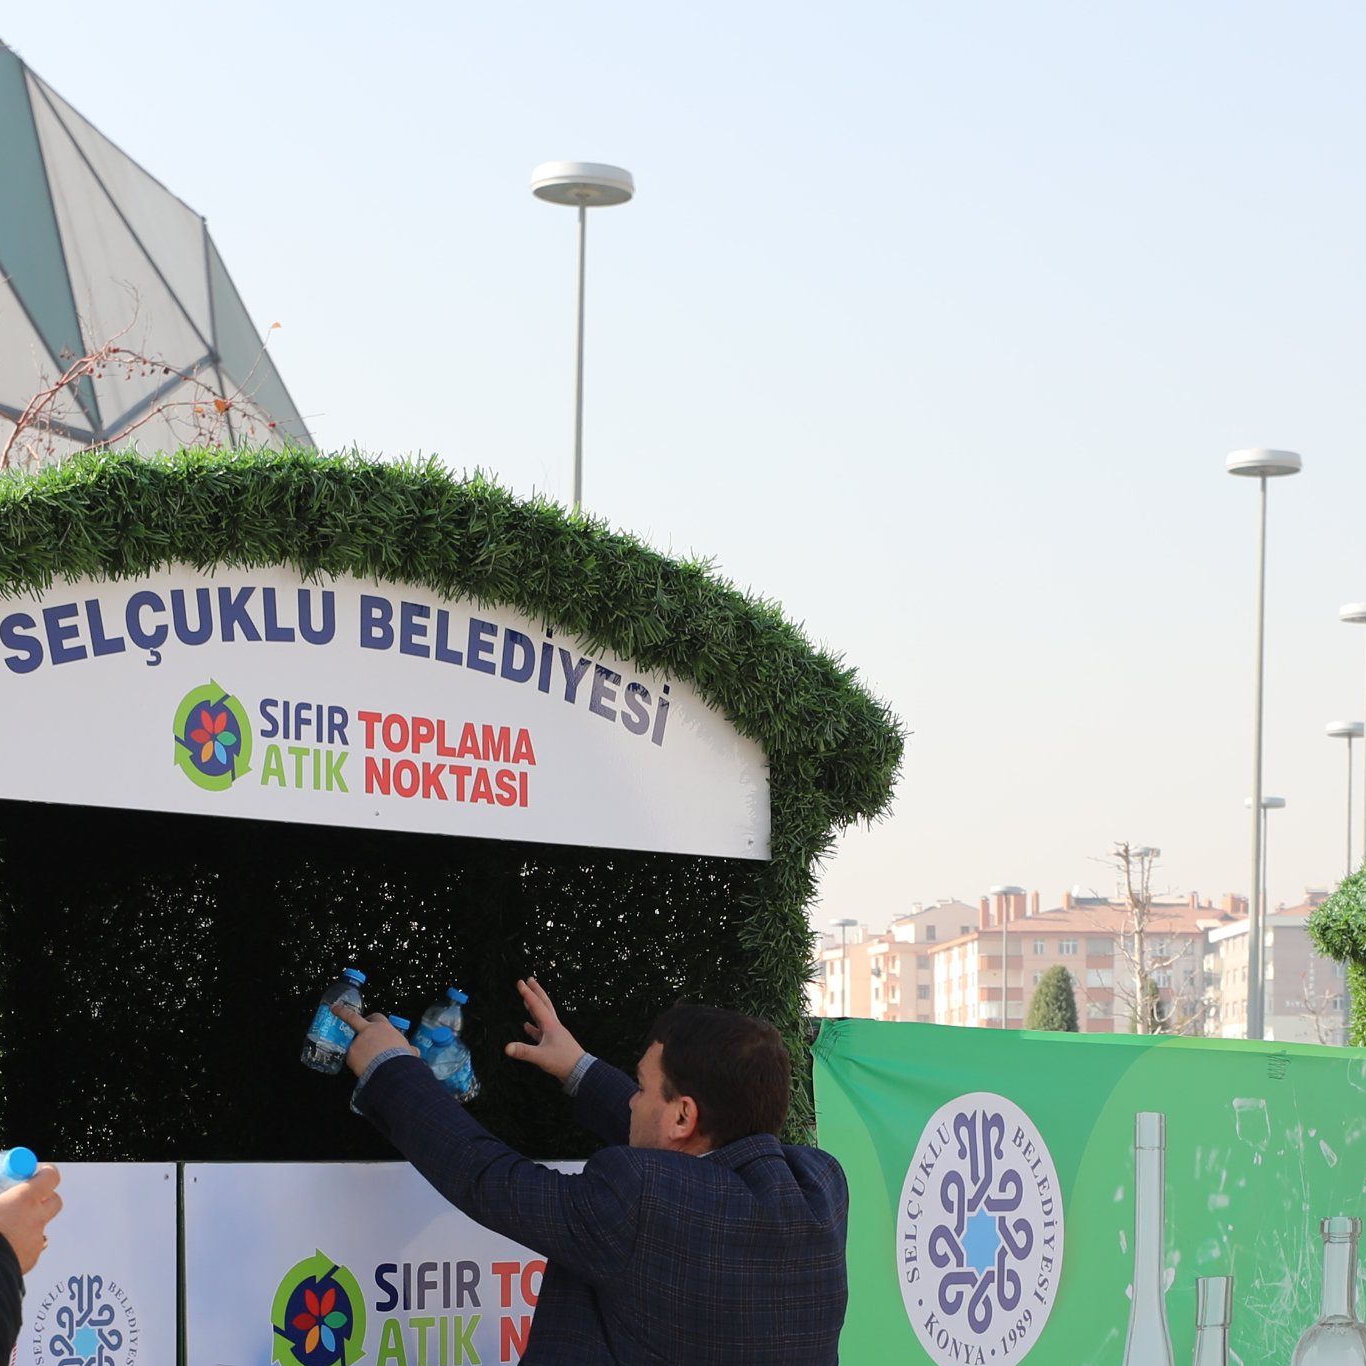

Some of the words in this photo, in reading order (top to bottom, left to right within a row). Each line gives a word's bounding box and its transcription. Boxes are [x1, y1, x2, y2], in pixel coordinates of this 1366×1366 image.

[0, 586, 336, 674] SELÇUKLU
[360, 594, 670, 748] BELEDİYESİ
[259, 698, 350, 746] SIFIR
[358, 710, 537, 766] TOPLAMA
[260, 743, 350, 793] ATIK
[365, 756, 528, 808] NOKTASI
[904, 1122, 951, 1284] SELÇUKLU
[1011, 1125, 1060, 1305] BELEDİYESİ
[374, 1259, 481, 1313] SIFIR
[32, 1281, 65, 1366] SELÇUKLU
[923, 1311, 986, 1366] KONYA
[1000, 1308, 1033, 1357] 1989
